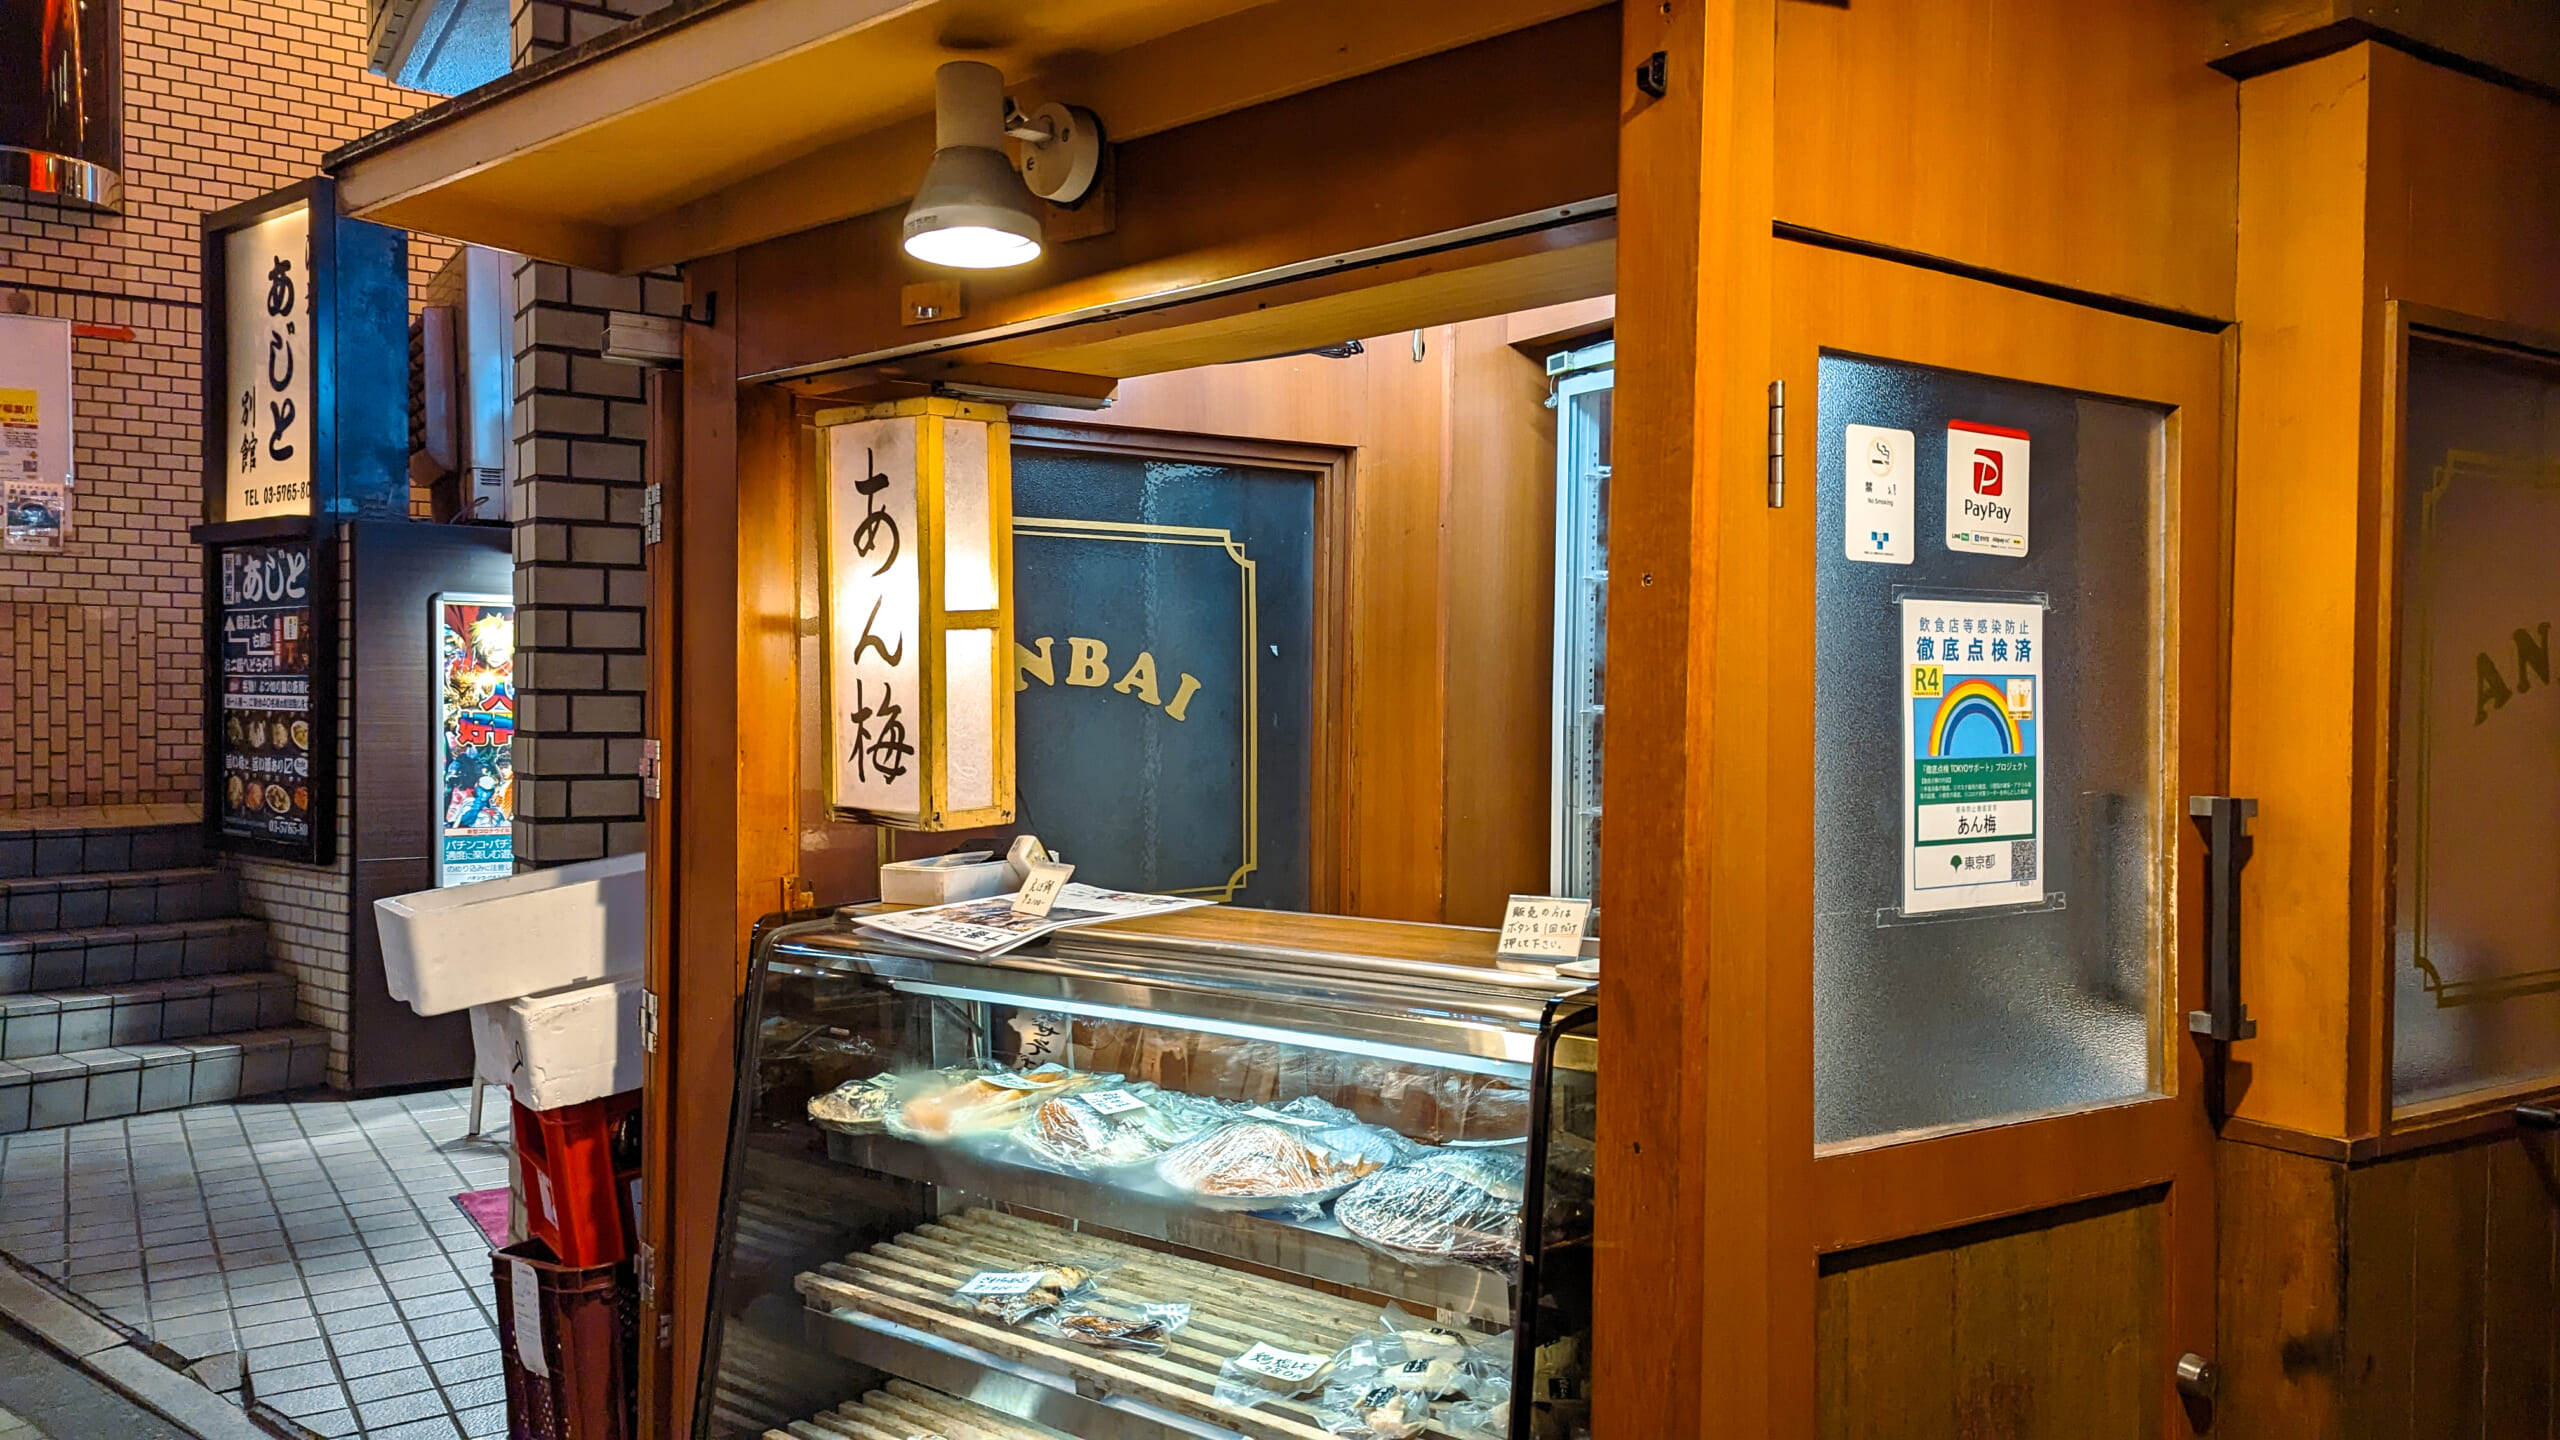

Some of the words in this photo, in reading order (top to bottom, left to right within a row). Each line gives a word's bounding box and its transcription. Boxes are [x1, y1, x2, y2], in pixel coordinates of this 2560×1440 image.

[267, 255, 295, 461] あじと
[241, 386, 257, 473] 別館
[244, 489, 259, 506] TEL
[263, 481, 310, 504] 03-5765-80
[1964, 499, 2011, 523] PayPay
[243, 550, 305, 602] あじと
[848, 447, 914, 785] あん梅
[1919, 617, 2030, 635] 飲食店等感染防止
[1916, 636, 2032, 663] 徹底点検済
[1014, 636, 1202, 722] NBAI
[1915, 667, 1939, 691] R4
[2475, 622, 2560, 726] AN
[1957, 814, 1997, 835] あん梅
[1964, 854, 1996, 870] 東京都
